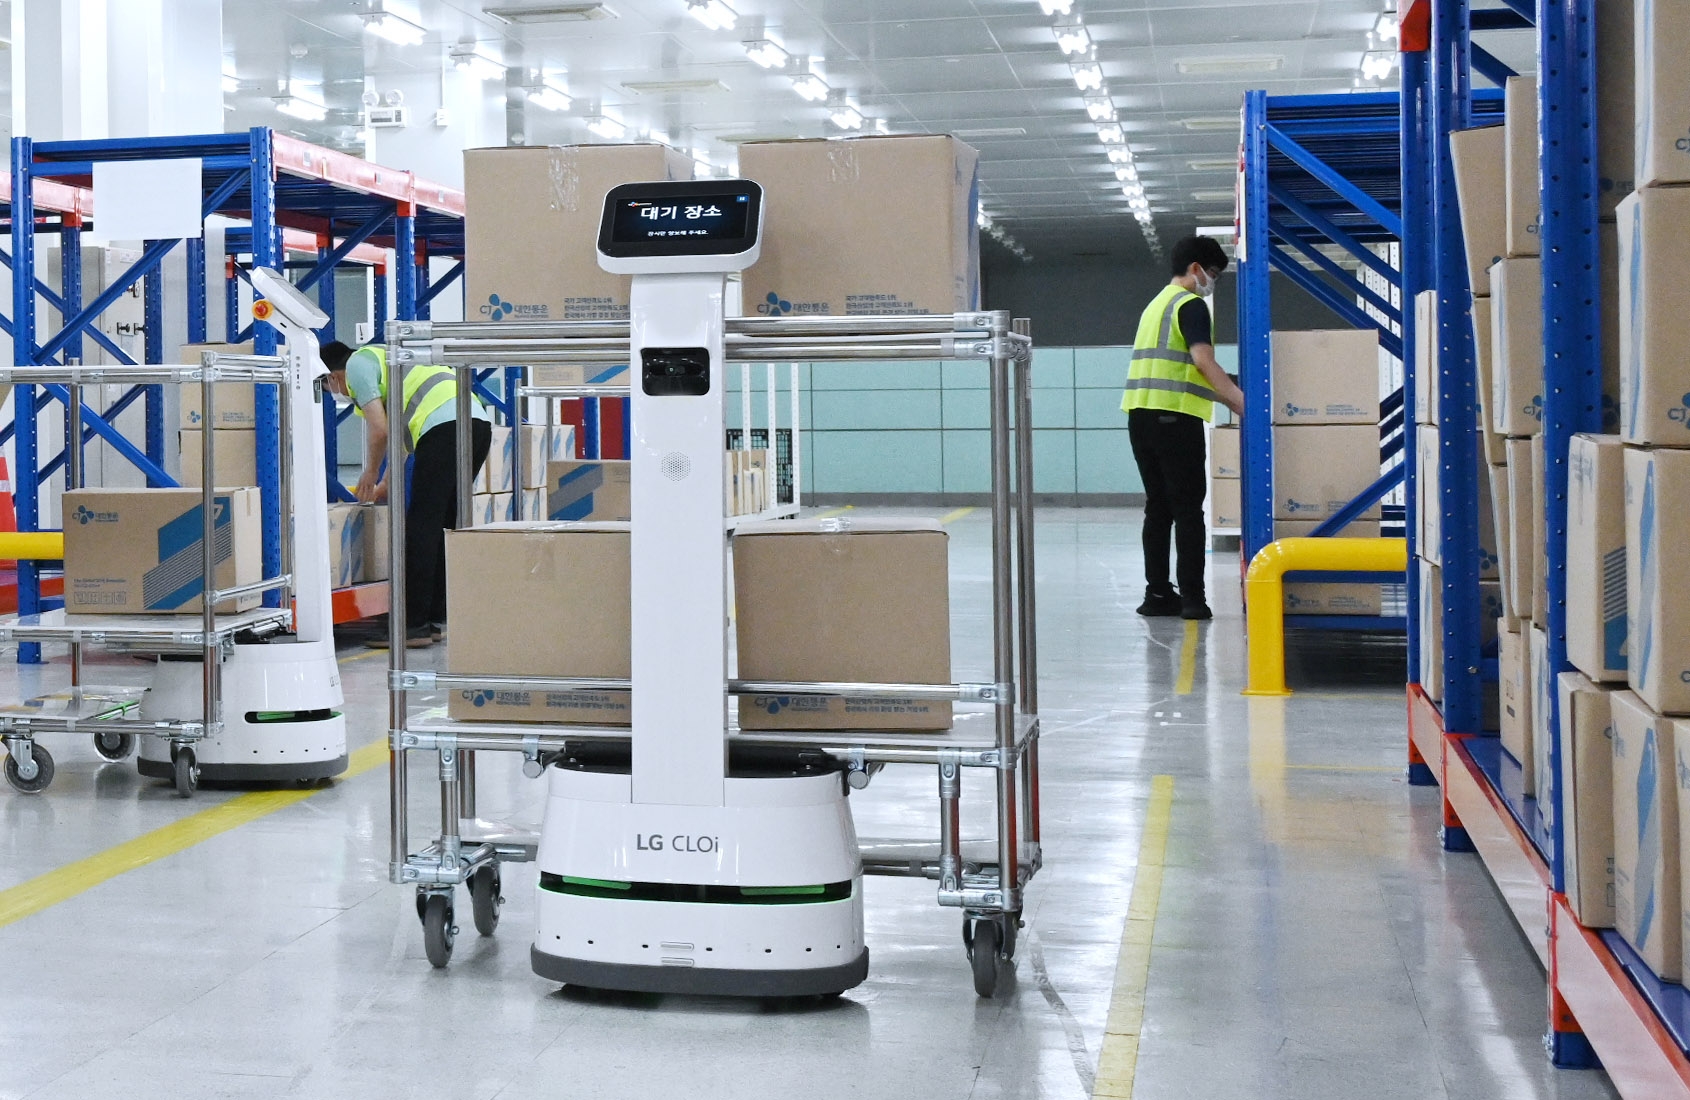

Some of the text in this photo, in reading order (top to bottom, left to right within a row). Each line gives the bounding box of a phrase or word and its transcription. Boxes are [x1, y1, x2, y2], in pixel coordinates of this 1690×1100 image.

[640, 204, 722, 221] 대기 장소
[480, 304, 548, 315] CJ 대한통운
[757, 304, 769, 314] CJ
[1667, 407, 1686, 422] CJ
[637, 834, 719, 853] LG CLOi
